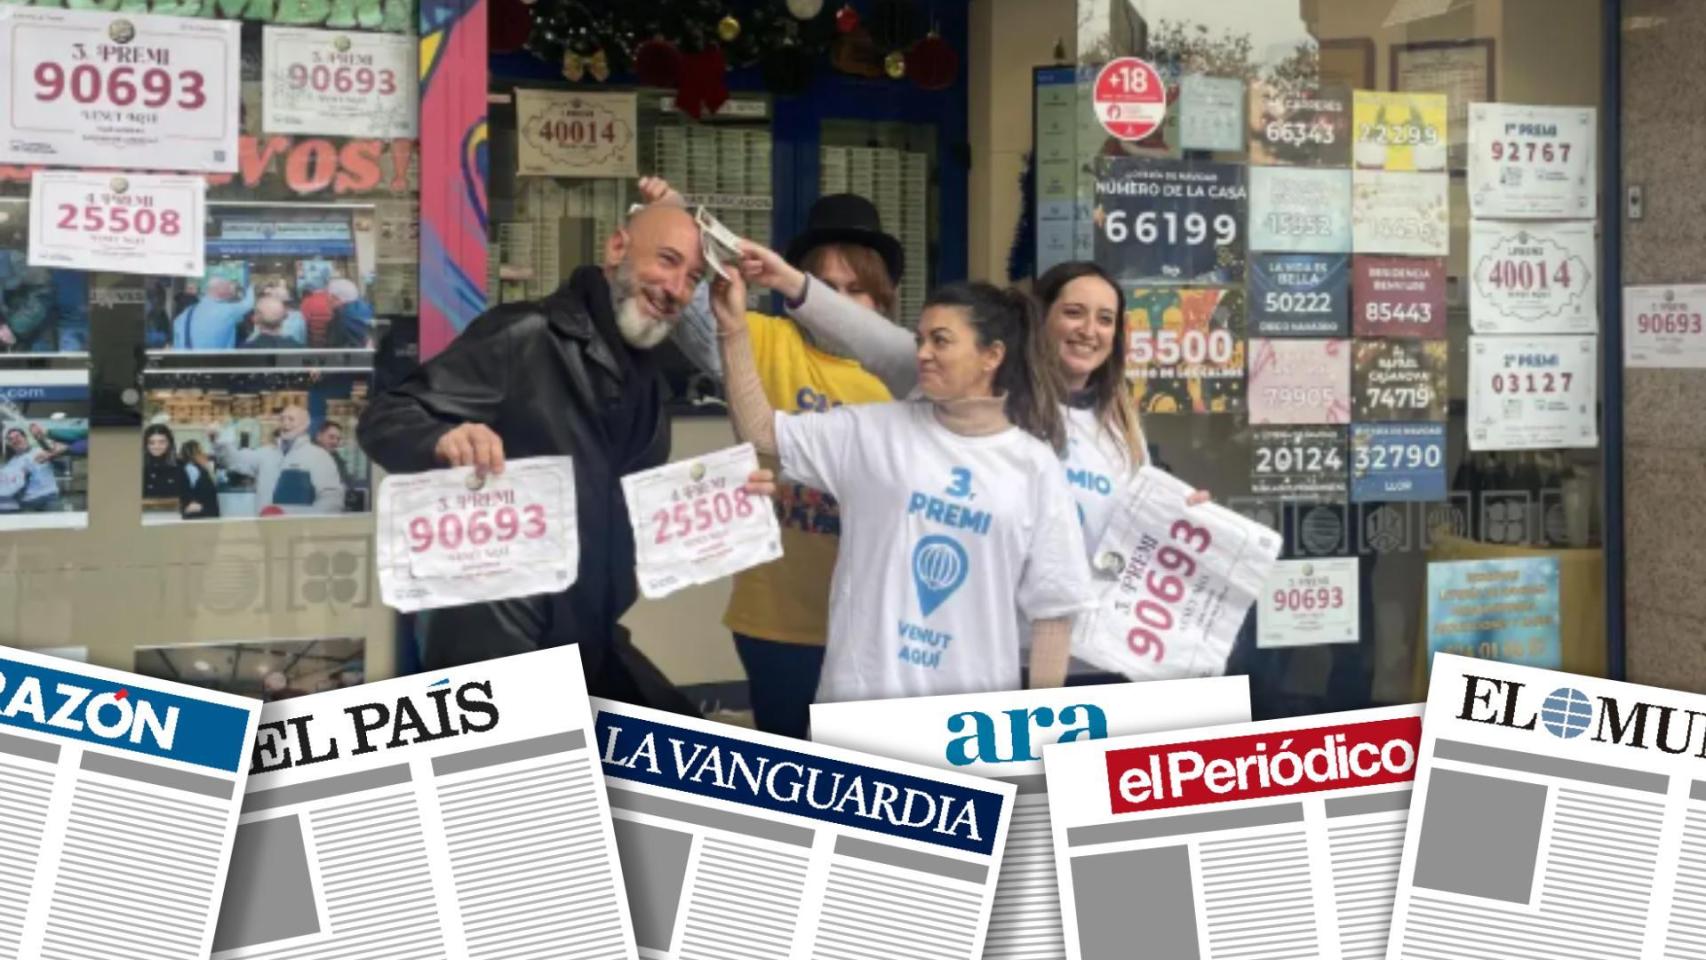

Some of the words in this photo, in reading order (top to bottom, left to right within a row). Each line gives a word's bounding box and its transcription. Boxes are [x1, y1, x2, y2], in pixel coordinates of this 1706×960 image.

[34, 61, 207, 110] 90693
[287, 63, 398, 96] 90693
[1107, 66, 1149, 94] +18
[538, 119, 616, 144] 40014
[1265, 121, 1336, 146] 66343
[1491, 141, 1571, 163] 92767
[1094, 176, 1161, 197] NÚMERO
[1163, 182, 1184, 198] DE
[1186, 184, 1206, 198] LA
[1207, 184, 1248, 200] CASA
[56, 203, 182, 236] 25508
[1104, 208, 1238, 247] 66199
[1489, 259, 1571, 289] 40014
[1264, 291, 1333, 314] 50222
[1365, 302, 1433, 324] 85443
[1638, 312, 1702, 334] 90693
[1128, 328, 1234, 364] 5500
[0, 387, 45, 399] .com
[1491, 372, 1573, 394] 03127
[1366, 387, 1434, 408] 74719
[1256, 447, 1343, 472] 20124
[1354, 444, 1441, 468] 32790
[1066, 467, 1111, 495] MIO
[652, 487, 753, 545] 25508
[908, 491, 992, 536] PREMI
[409, 503, 547, 554] 90693
[1126, 519, 1212, 664] 90693
[1273, 586, 1344, 612] 90693
[898, 619, 952, 649] VENUT
[898, 646, 942, 669] AQUÍ
